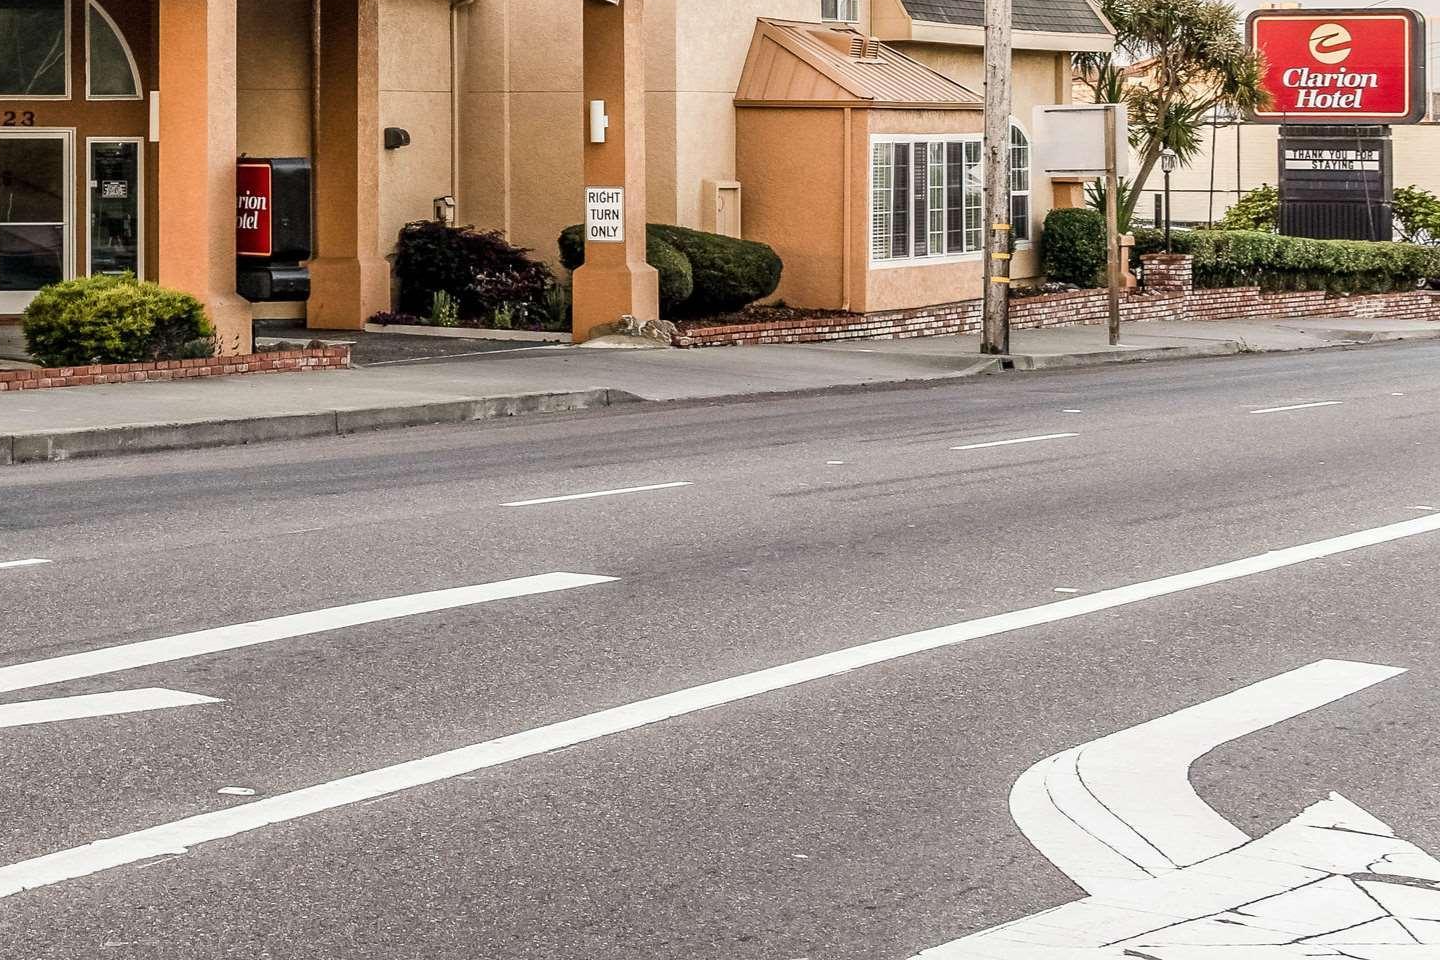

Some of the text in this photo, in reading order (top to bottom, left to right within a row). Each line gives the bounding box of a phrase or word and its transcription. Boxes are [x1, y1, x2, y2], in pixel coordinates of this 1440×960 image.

[1282, 66, 1378, 88] Clarion
[1294, 88, 1363, 108] Hotel
[1293, 149, 1373, 160] THANK YOU FOR
[1311, 160, 1354, 170] STAYING
[238, 190, 267, 210] rion
[588, 191, 621, 204] RIGHT
[237, 210, 259, 229] otel
[590, 208, 620, 221] TURN
[591, 225, 618, 238] ONLY
